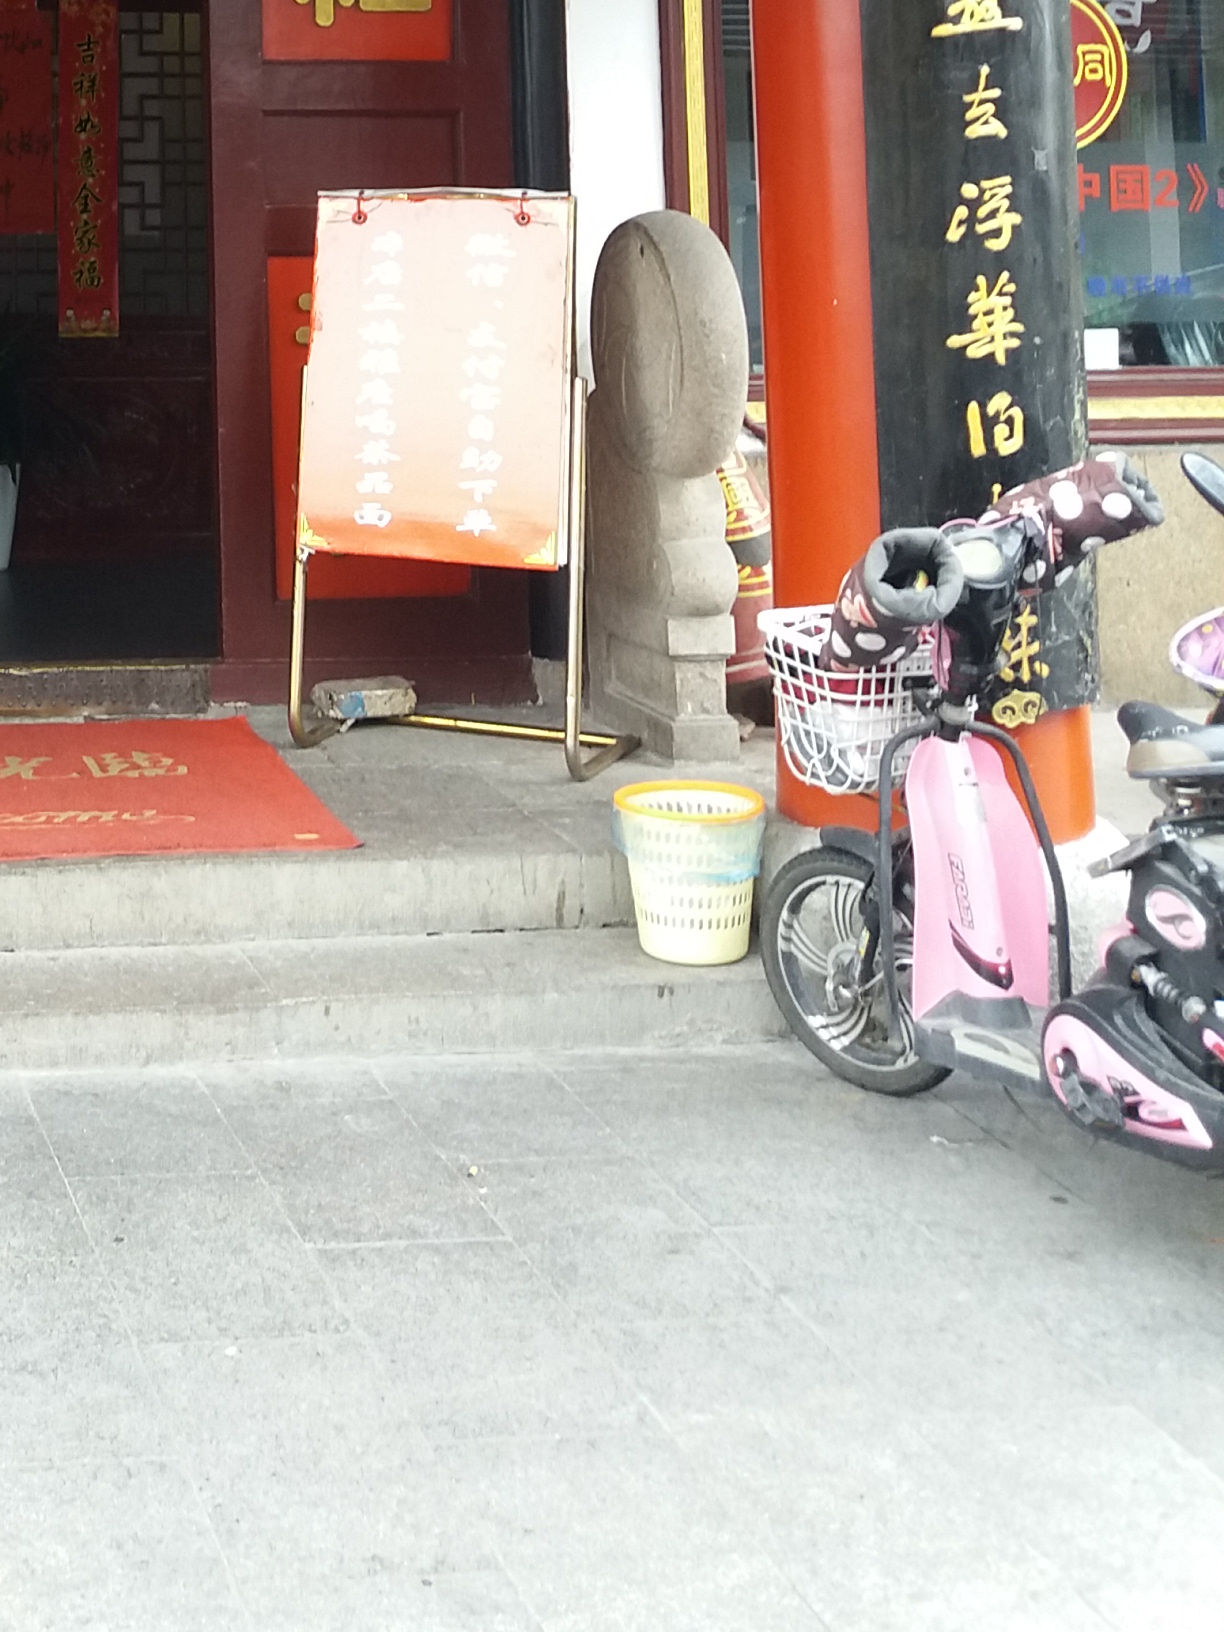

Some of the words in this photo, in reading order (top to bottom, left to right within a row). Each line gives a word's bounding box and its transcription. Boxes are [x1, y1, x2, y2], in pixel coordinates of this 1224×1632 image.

[71, 35, 104, 290] 吉祥如意全家福
